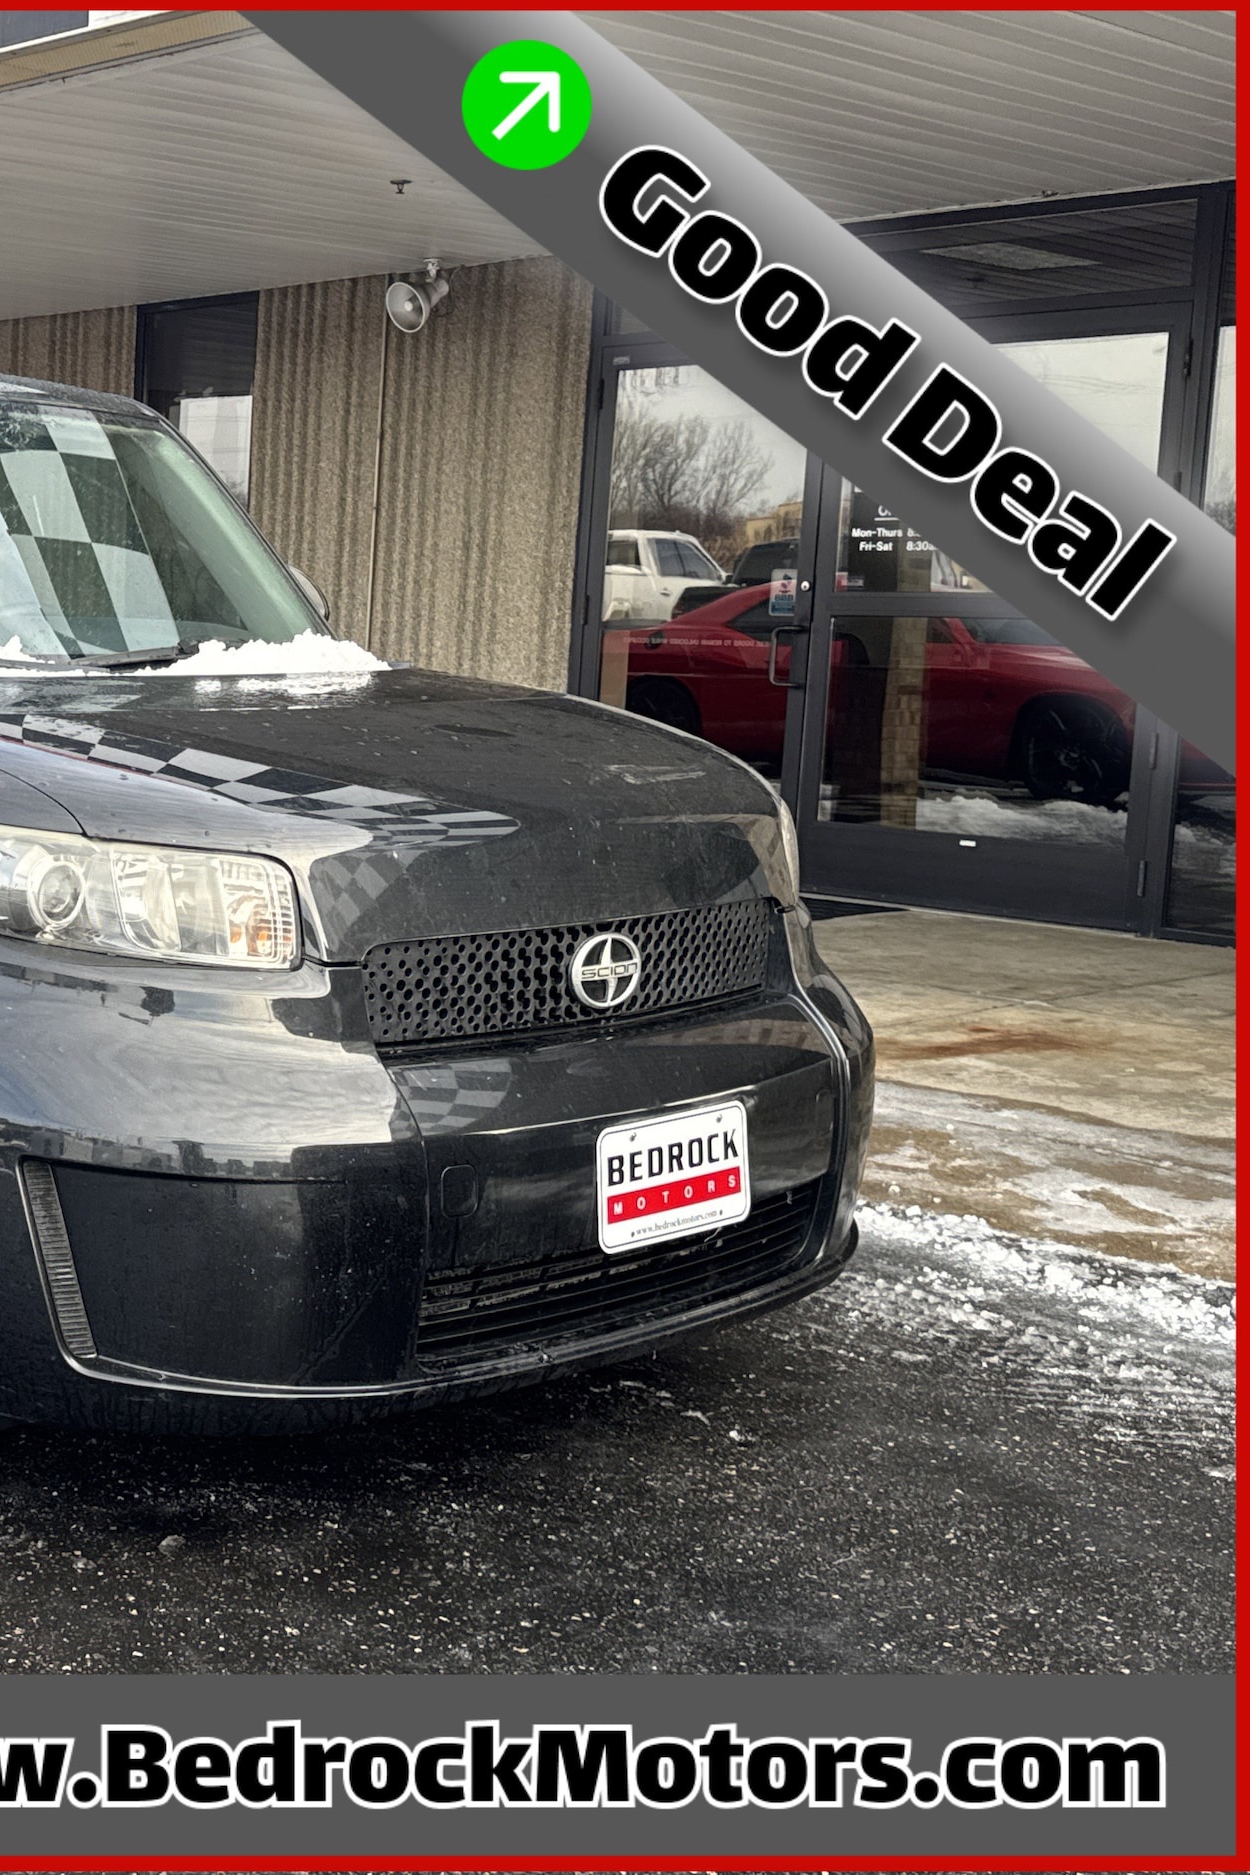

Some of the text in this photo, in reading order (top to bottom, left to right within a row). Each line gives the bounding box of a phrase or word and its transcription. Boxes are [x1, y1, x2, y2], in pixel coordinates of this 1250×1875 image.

[851, 527, 903, 538] Mon-Thurs
[859, 541, 893, 552] Fri-Sat
[581, 962, 638, 980] SCION
[607, 1128, 739, 1187] BEDROCK
[613, 1174, 737, 1216] MOTORS
[636, 1210, 717, 1235] www.bedrockmotors.com
